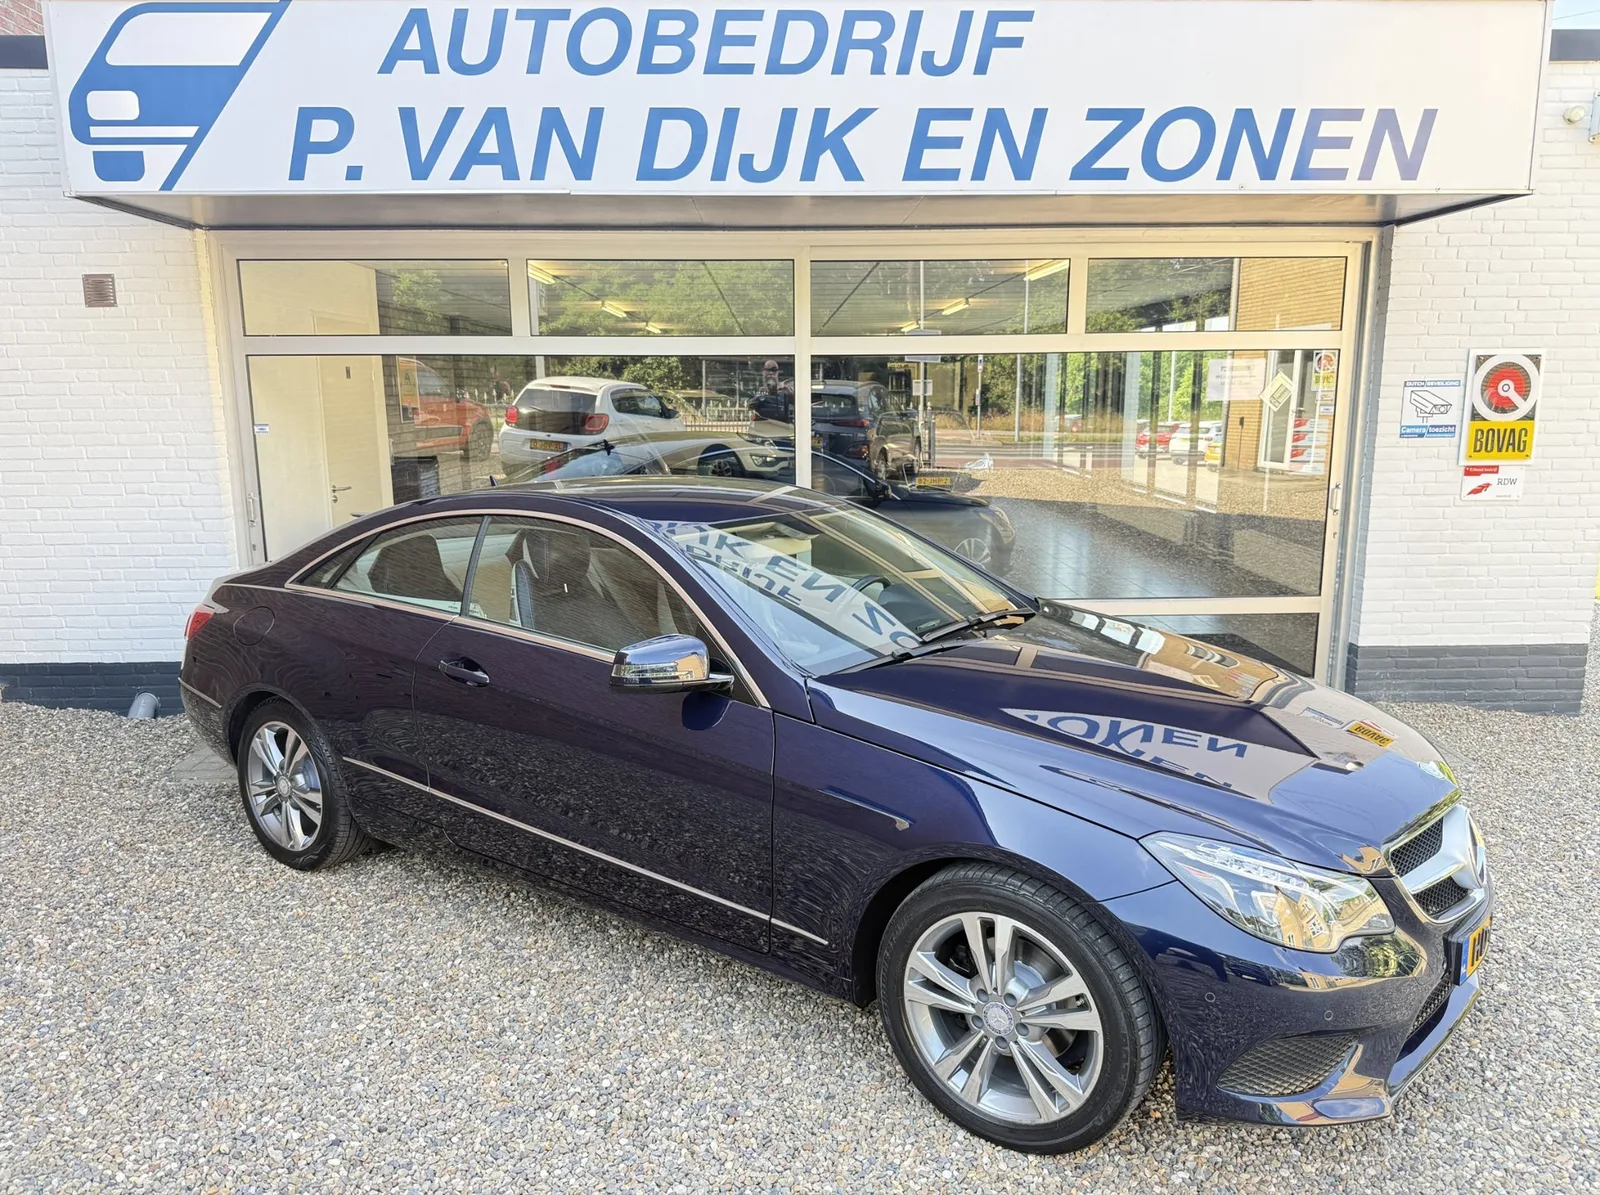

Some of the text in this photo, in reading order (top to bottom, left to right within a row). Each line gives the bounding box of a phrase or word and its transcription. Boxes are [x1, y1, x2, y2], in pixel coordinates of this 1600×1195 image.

[378, 8, 1034, 77] AUTOBEDRIJF
[289, 106, 1438, 183] P. VAN DIJK EN ZONEN
[1473, 427, 1528, 453] BOVAG
[1496, 477, 1518, 486] RDW
